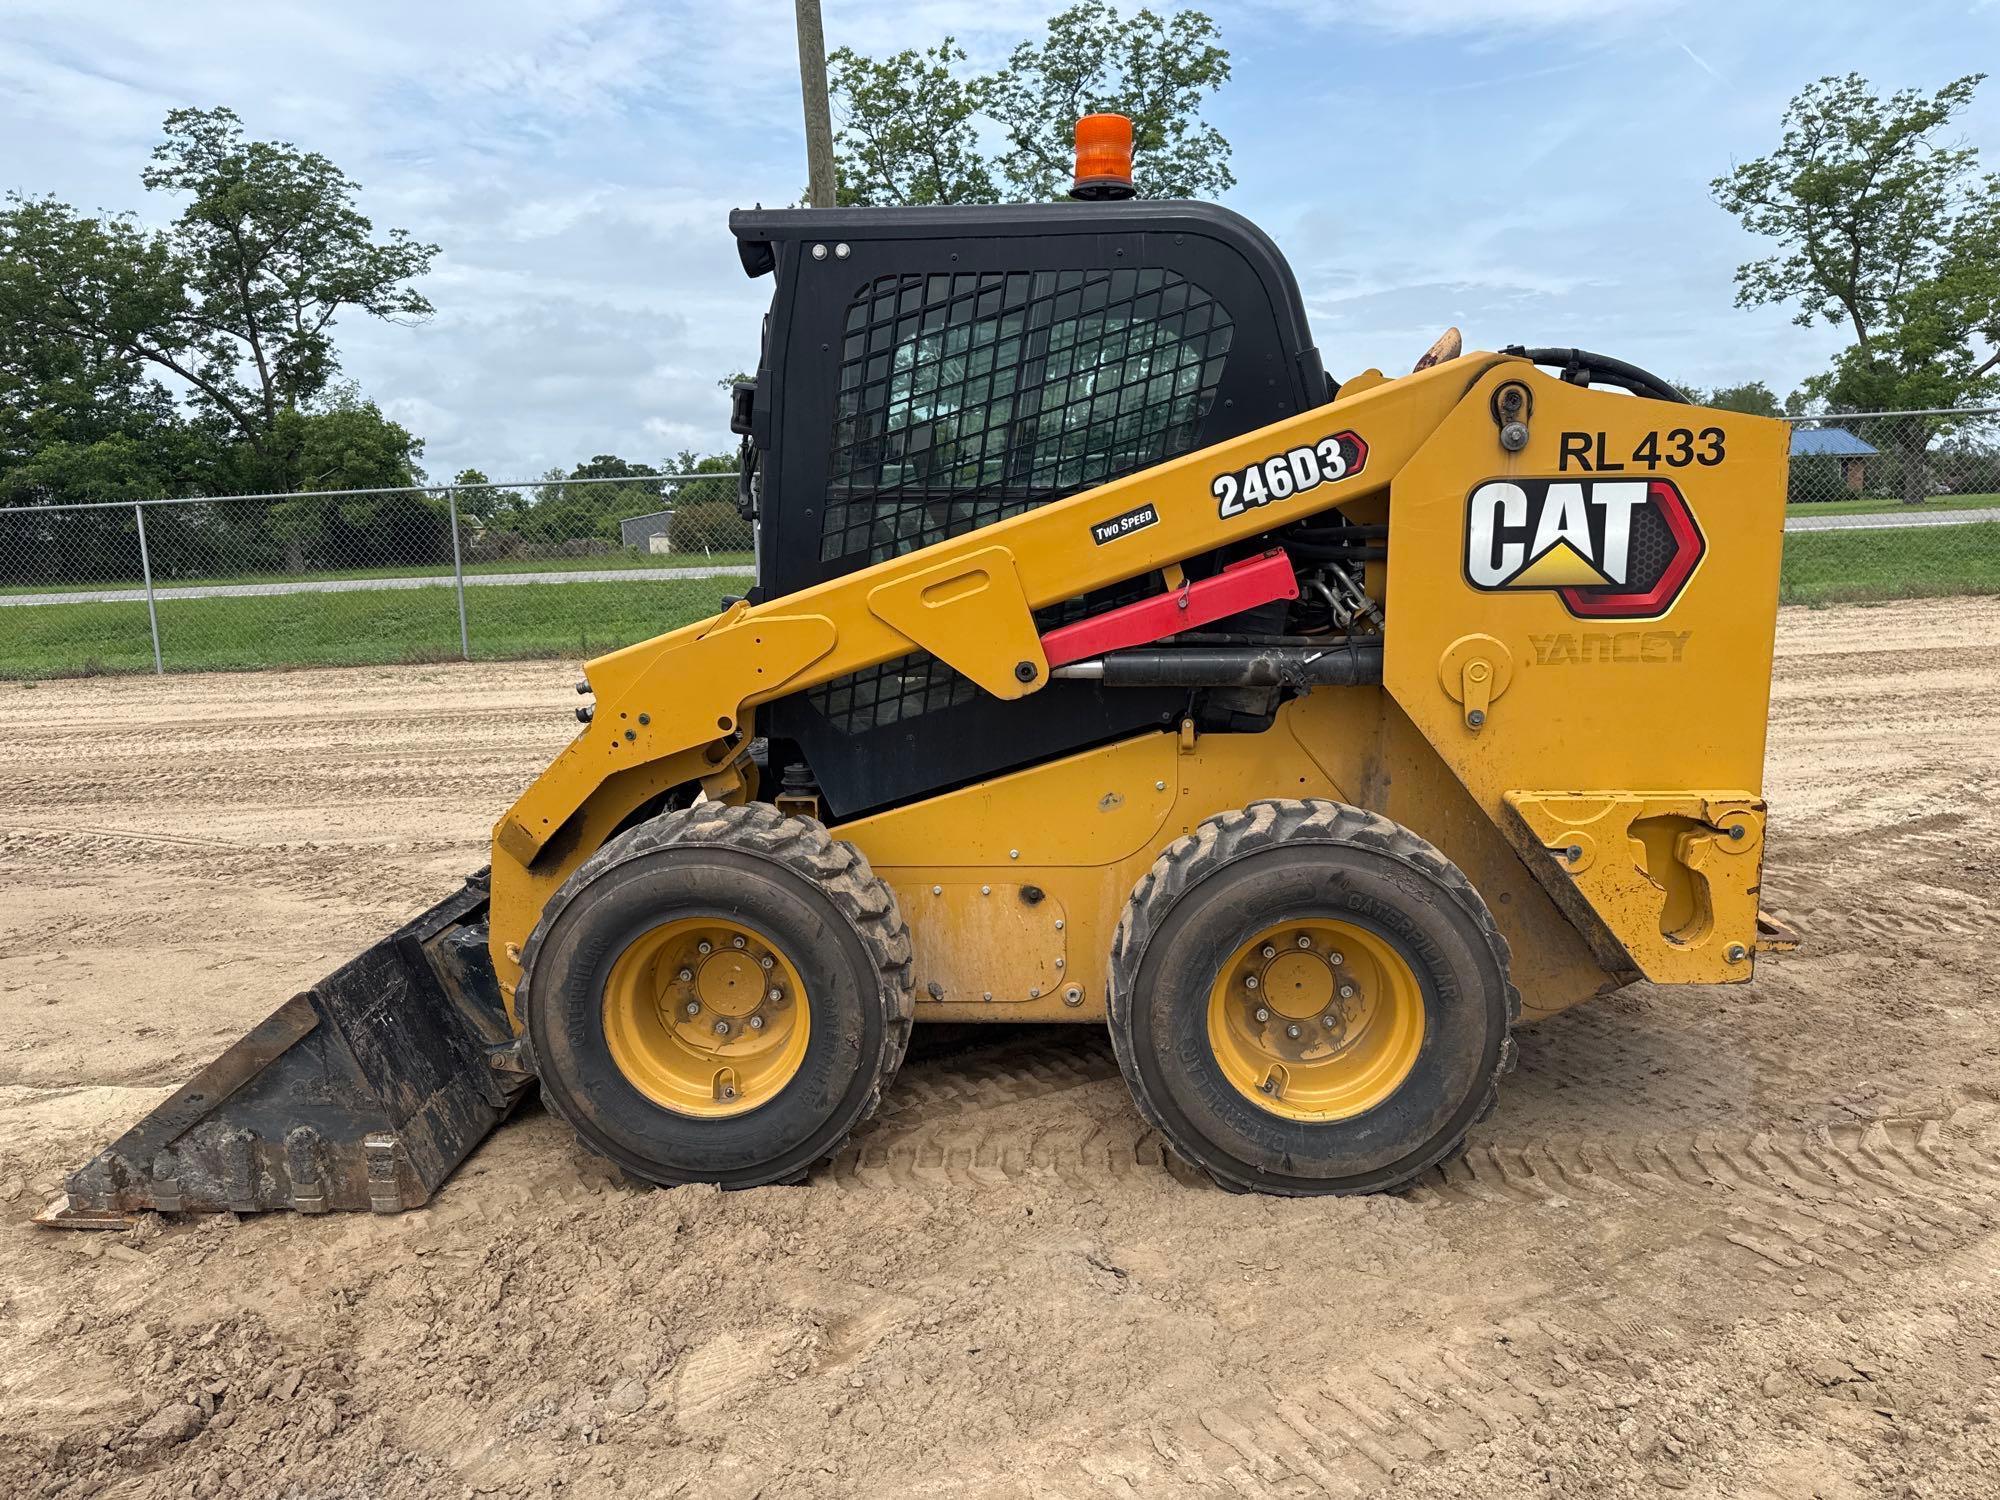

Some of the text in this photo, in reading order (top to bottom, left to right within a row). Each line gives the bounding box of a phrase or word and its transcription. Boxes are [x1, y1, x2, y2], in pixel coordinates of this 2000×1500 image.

[1213, 438, 1347, 518] 246D3
[1558, 427, 1727, 472] RL 433
[1096, 510, 1152, 540] TWO SPEED
[1468, 481, 1648, 587] CAT
[1528, 630, 1694, 666] YANCEY
[1347, 892, 1458, 1004] CATERPILLAR
[568, 935, 610, 1048] CATERPILLAR
